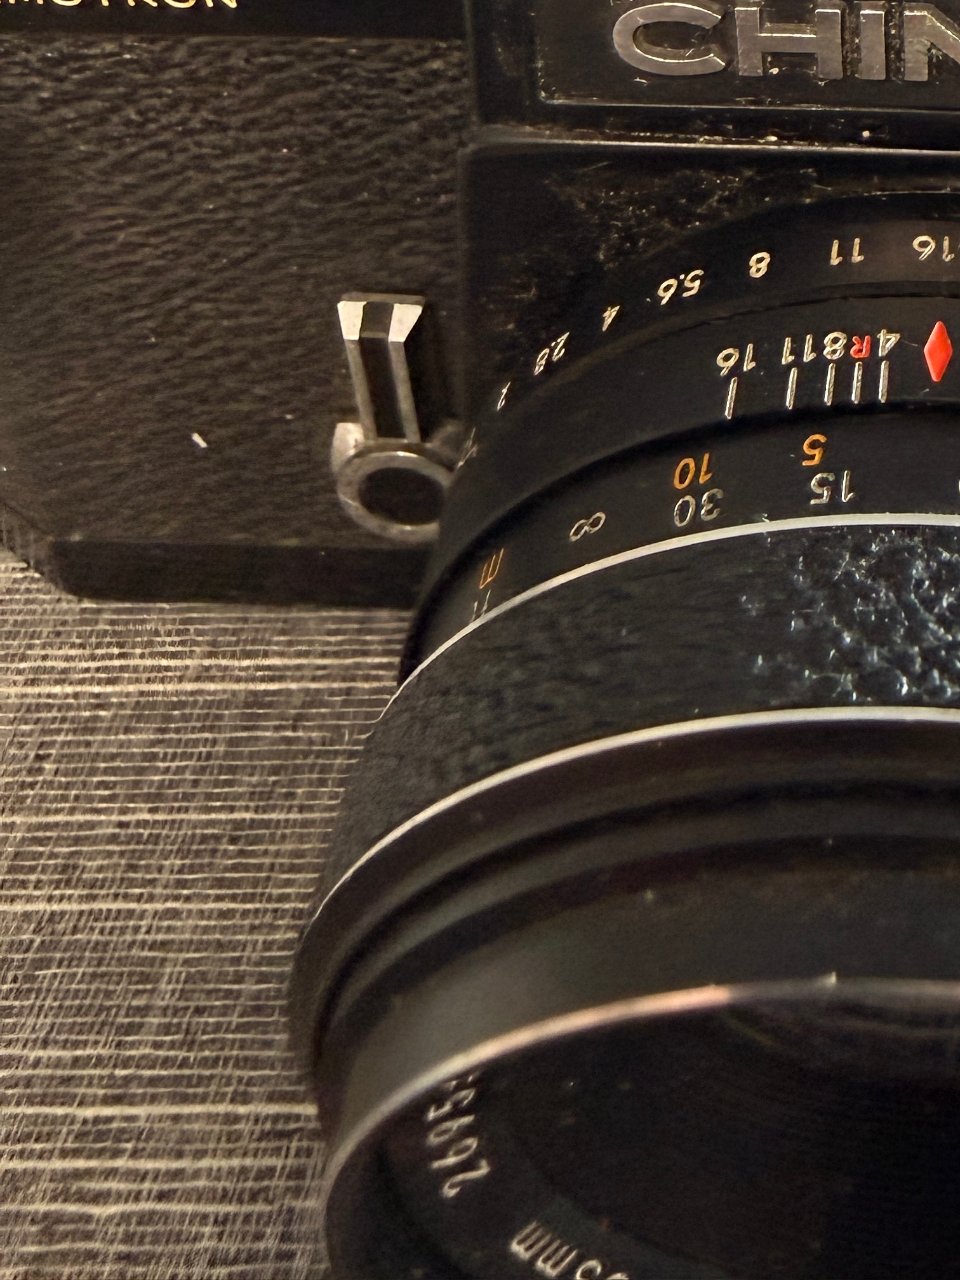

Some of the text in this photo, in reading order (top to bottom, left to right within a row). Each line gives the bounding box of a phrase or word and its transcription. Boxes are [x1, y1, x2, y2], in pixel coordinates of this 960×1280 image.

[829, 236, 865, 266] 11
[912, 235, 956, 263] 16
[748, 251, 771, 279] 8
[657, 269, 704, 306] 5.6
[602, 304, 620, 332] 4
[781, 334, 817, 366] 11
[822, 331, 848, 361] 8
[849, 334, 871, 359] R
[876, 328, 901, 358] 4
[716, 342, 756, 377] 16
[802, 433, 828, 467] 5
[673, 452, 714, 490] 10
[810, 470, 855, 506] 15
[673, 488, 724, 528] 30
